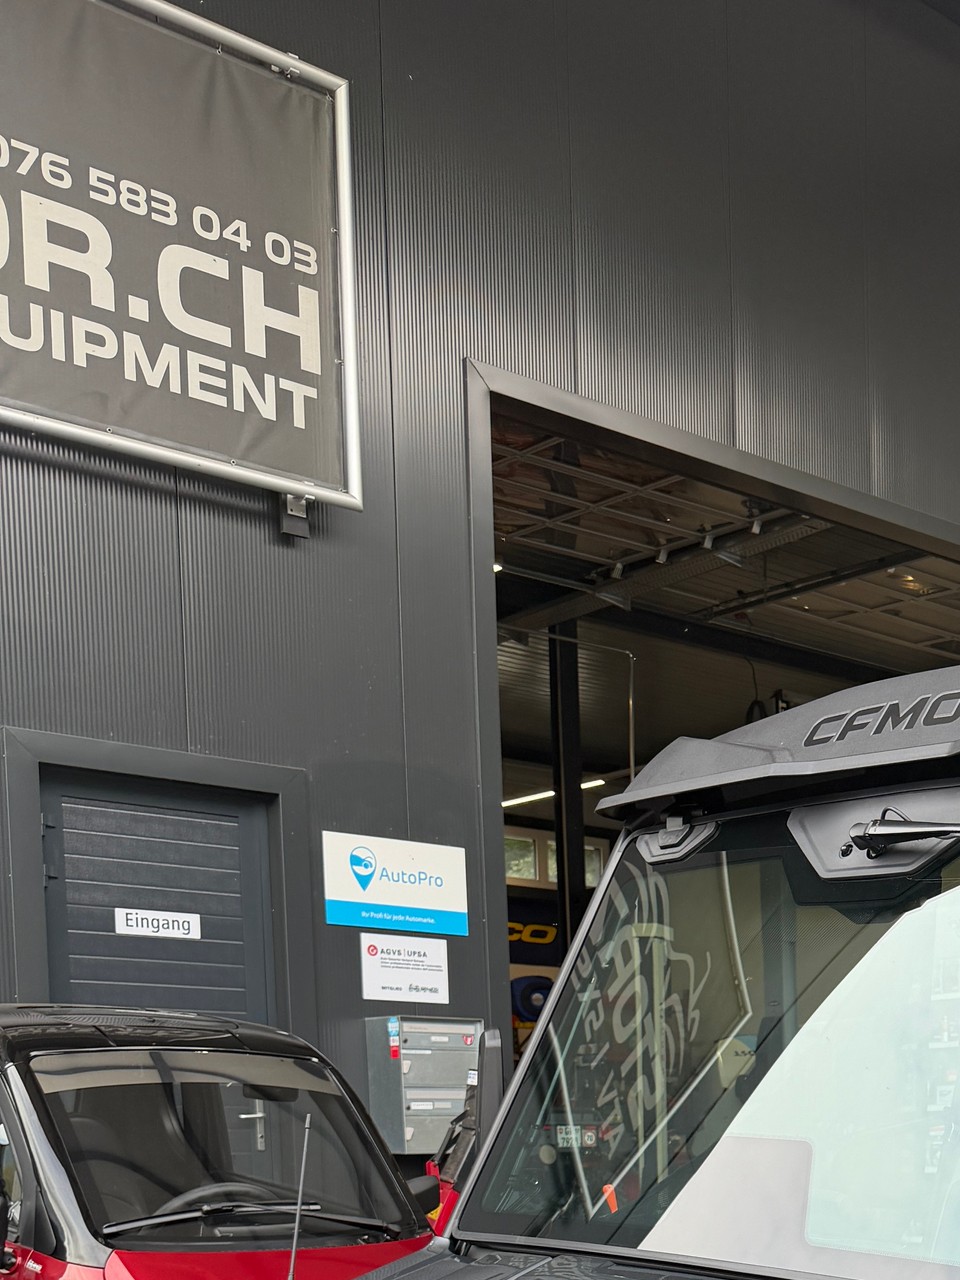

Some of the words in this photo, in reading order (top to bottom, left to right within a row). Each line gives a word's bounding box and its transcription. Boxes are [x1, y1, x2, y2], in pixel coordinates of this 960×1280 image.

[89, 166, 178, 226] 583
[193, 206, 251, 252] 04
[265, 232, 318, 275] 03
[0, 190, 321, 375] R.CH
[379, 867, 443, 887] AutoPro
[125, 912, 190, 935] Eingang
